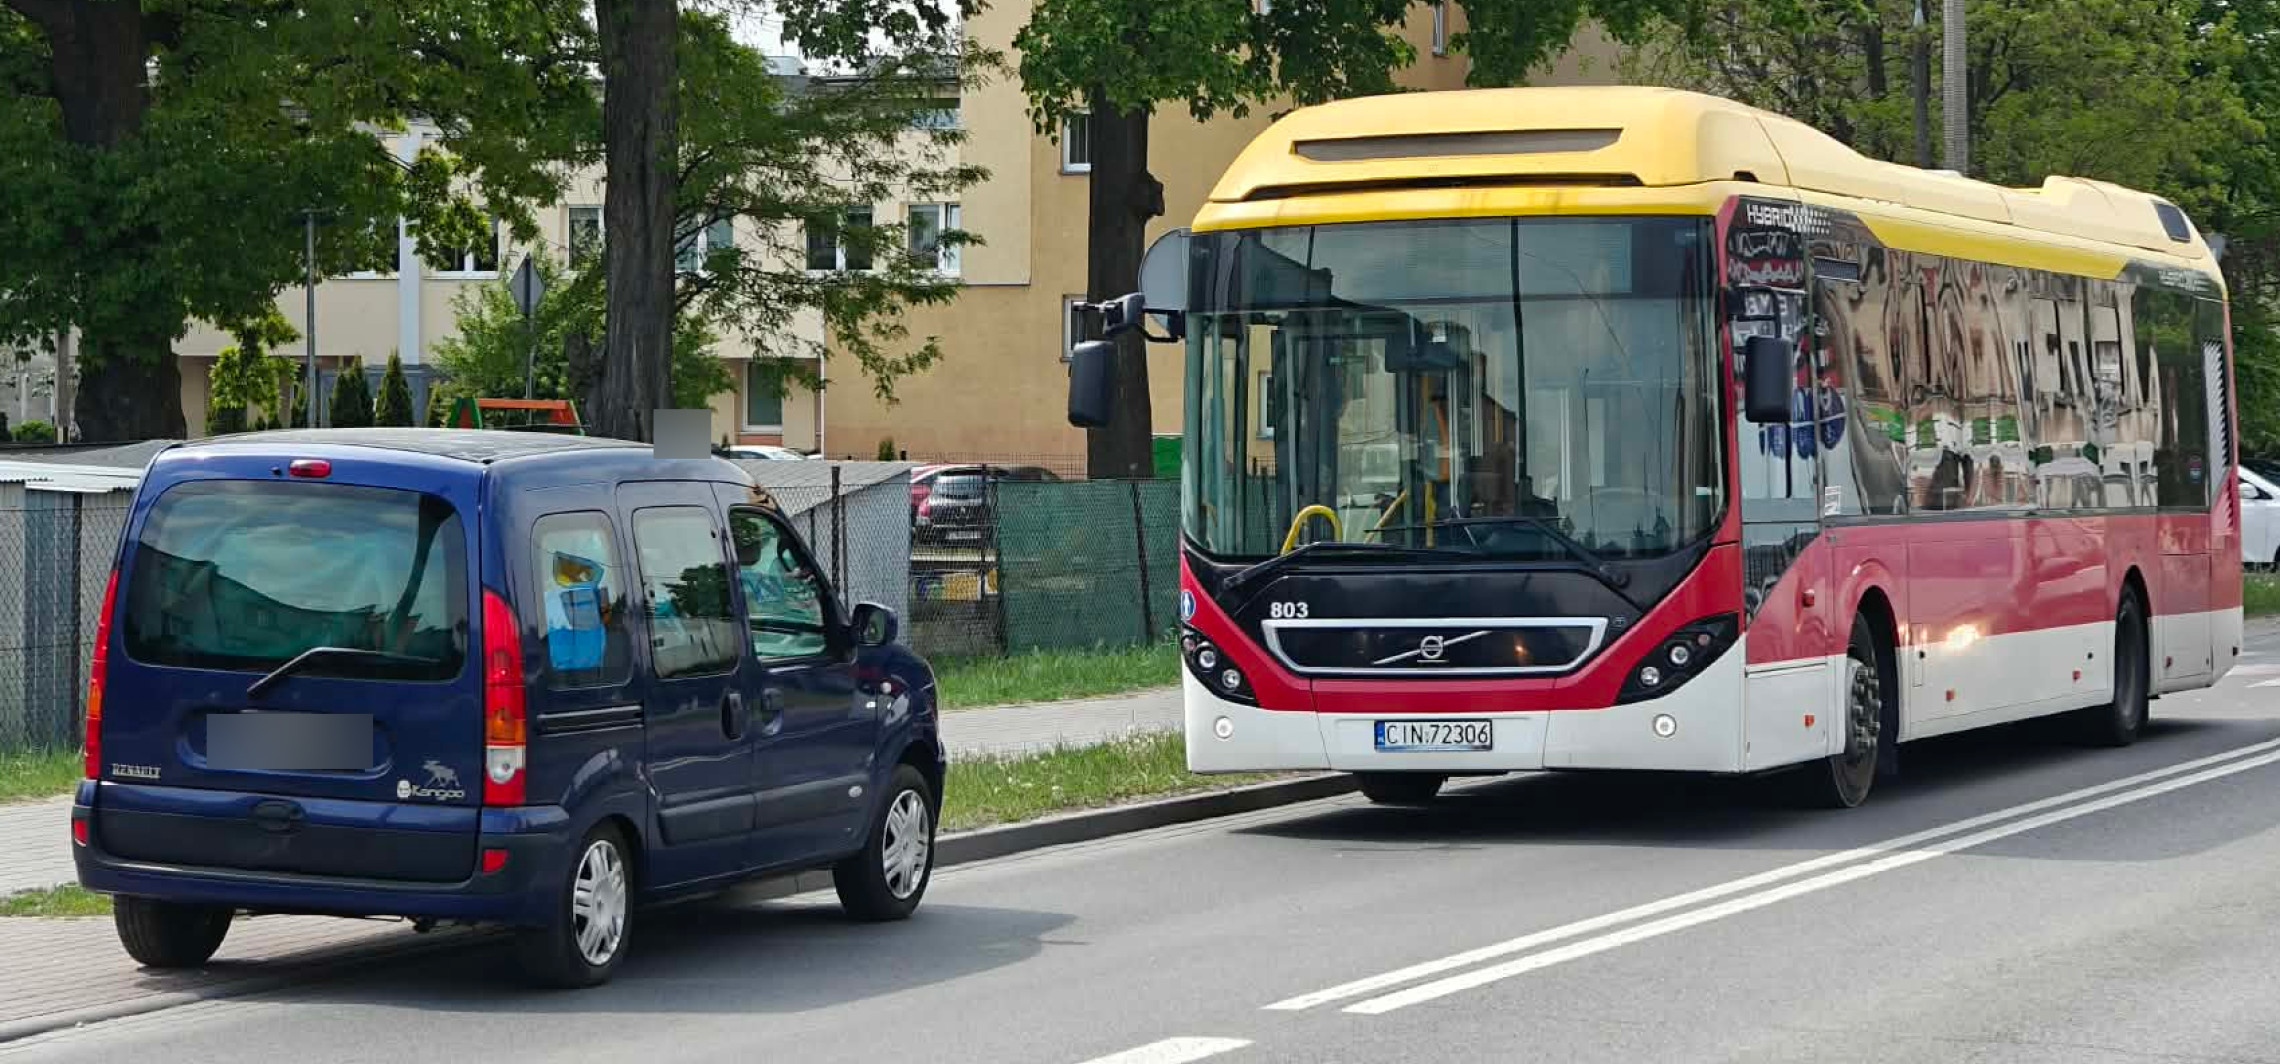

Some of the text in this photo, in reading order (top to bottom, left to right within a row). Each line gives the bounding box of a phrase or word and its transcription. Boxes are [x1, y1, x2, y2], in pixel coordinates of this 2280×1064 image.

[1271, 601, 1308, 618] 803
[1387, 725, 1423, 744] CIN
[1429, 724, 1488, 744] 72306
[412, 784, 464, 801] Kangoo
